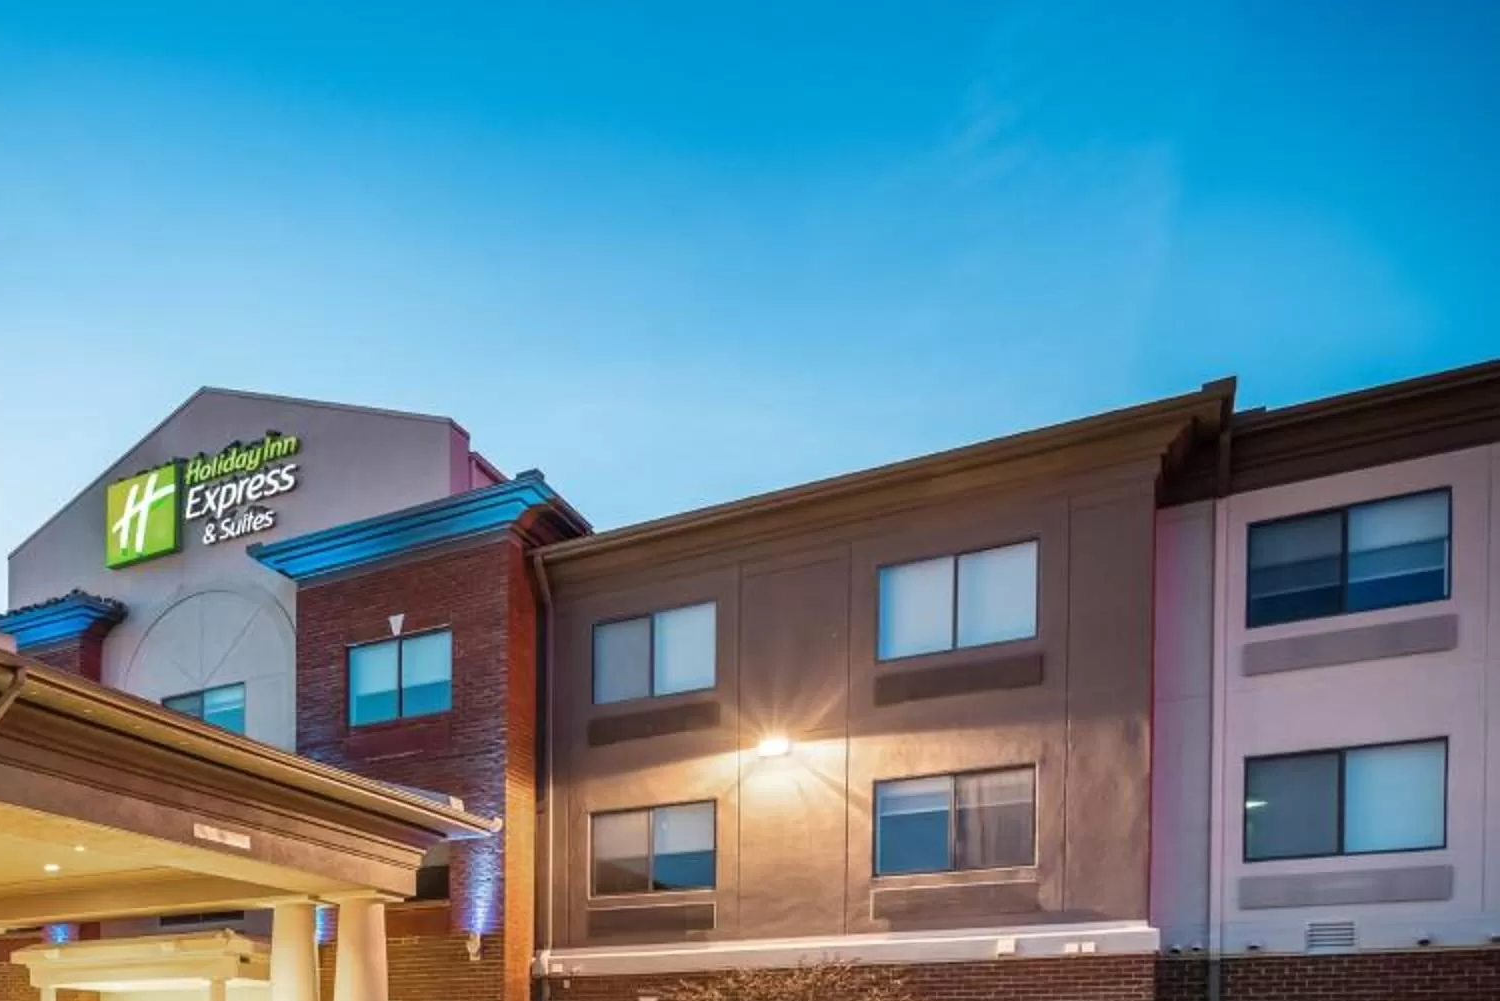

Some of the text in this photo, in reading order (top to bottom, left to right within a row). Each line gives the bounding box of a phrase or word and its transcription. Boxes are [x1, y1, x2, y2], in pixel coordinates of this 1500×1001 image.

[186, 436, 297, 485] Holiday Inn
[186, 464, 296, 519] Express
[203, 510, 274, 544] & Suites
